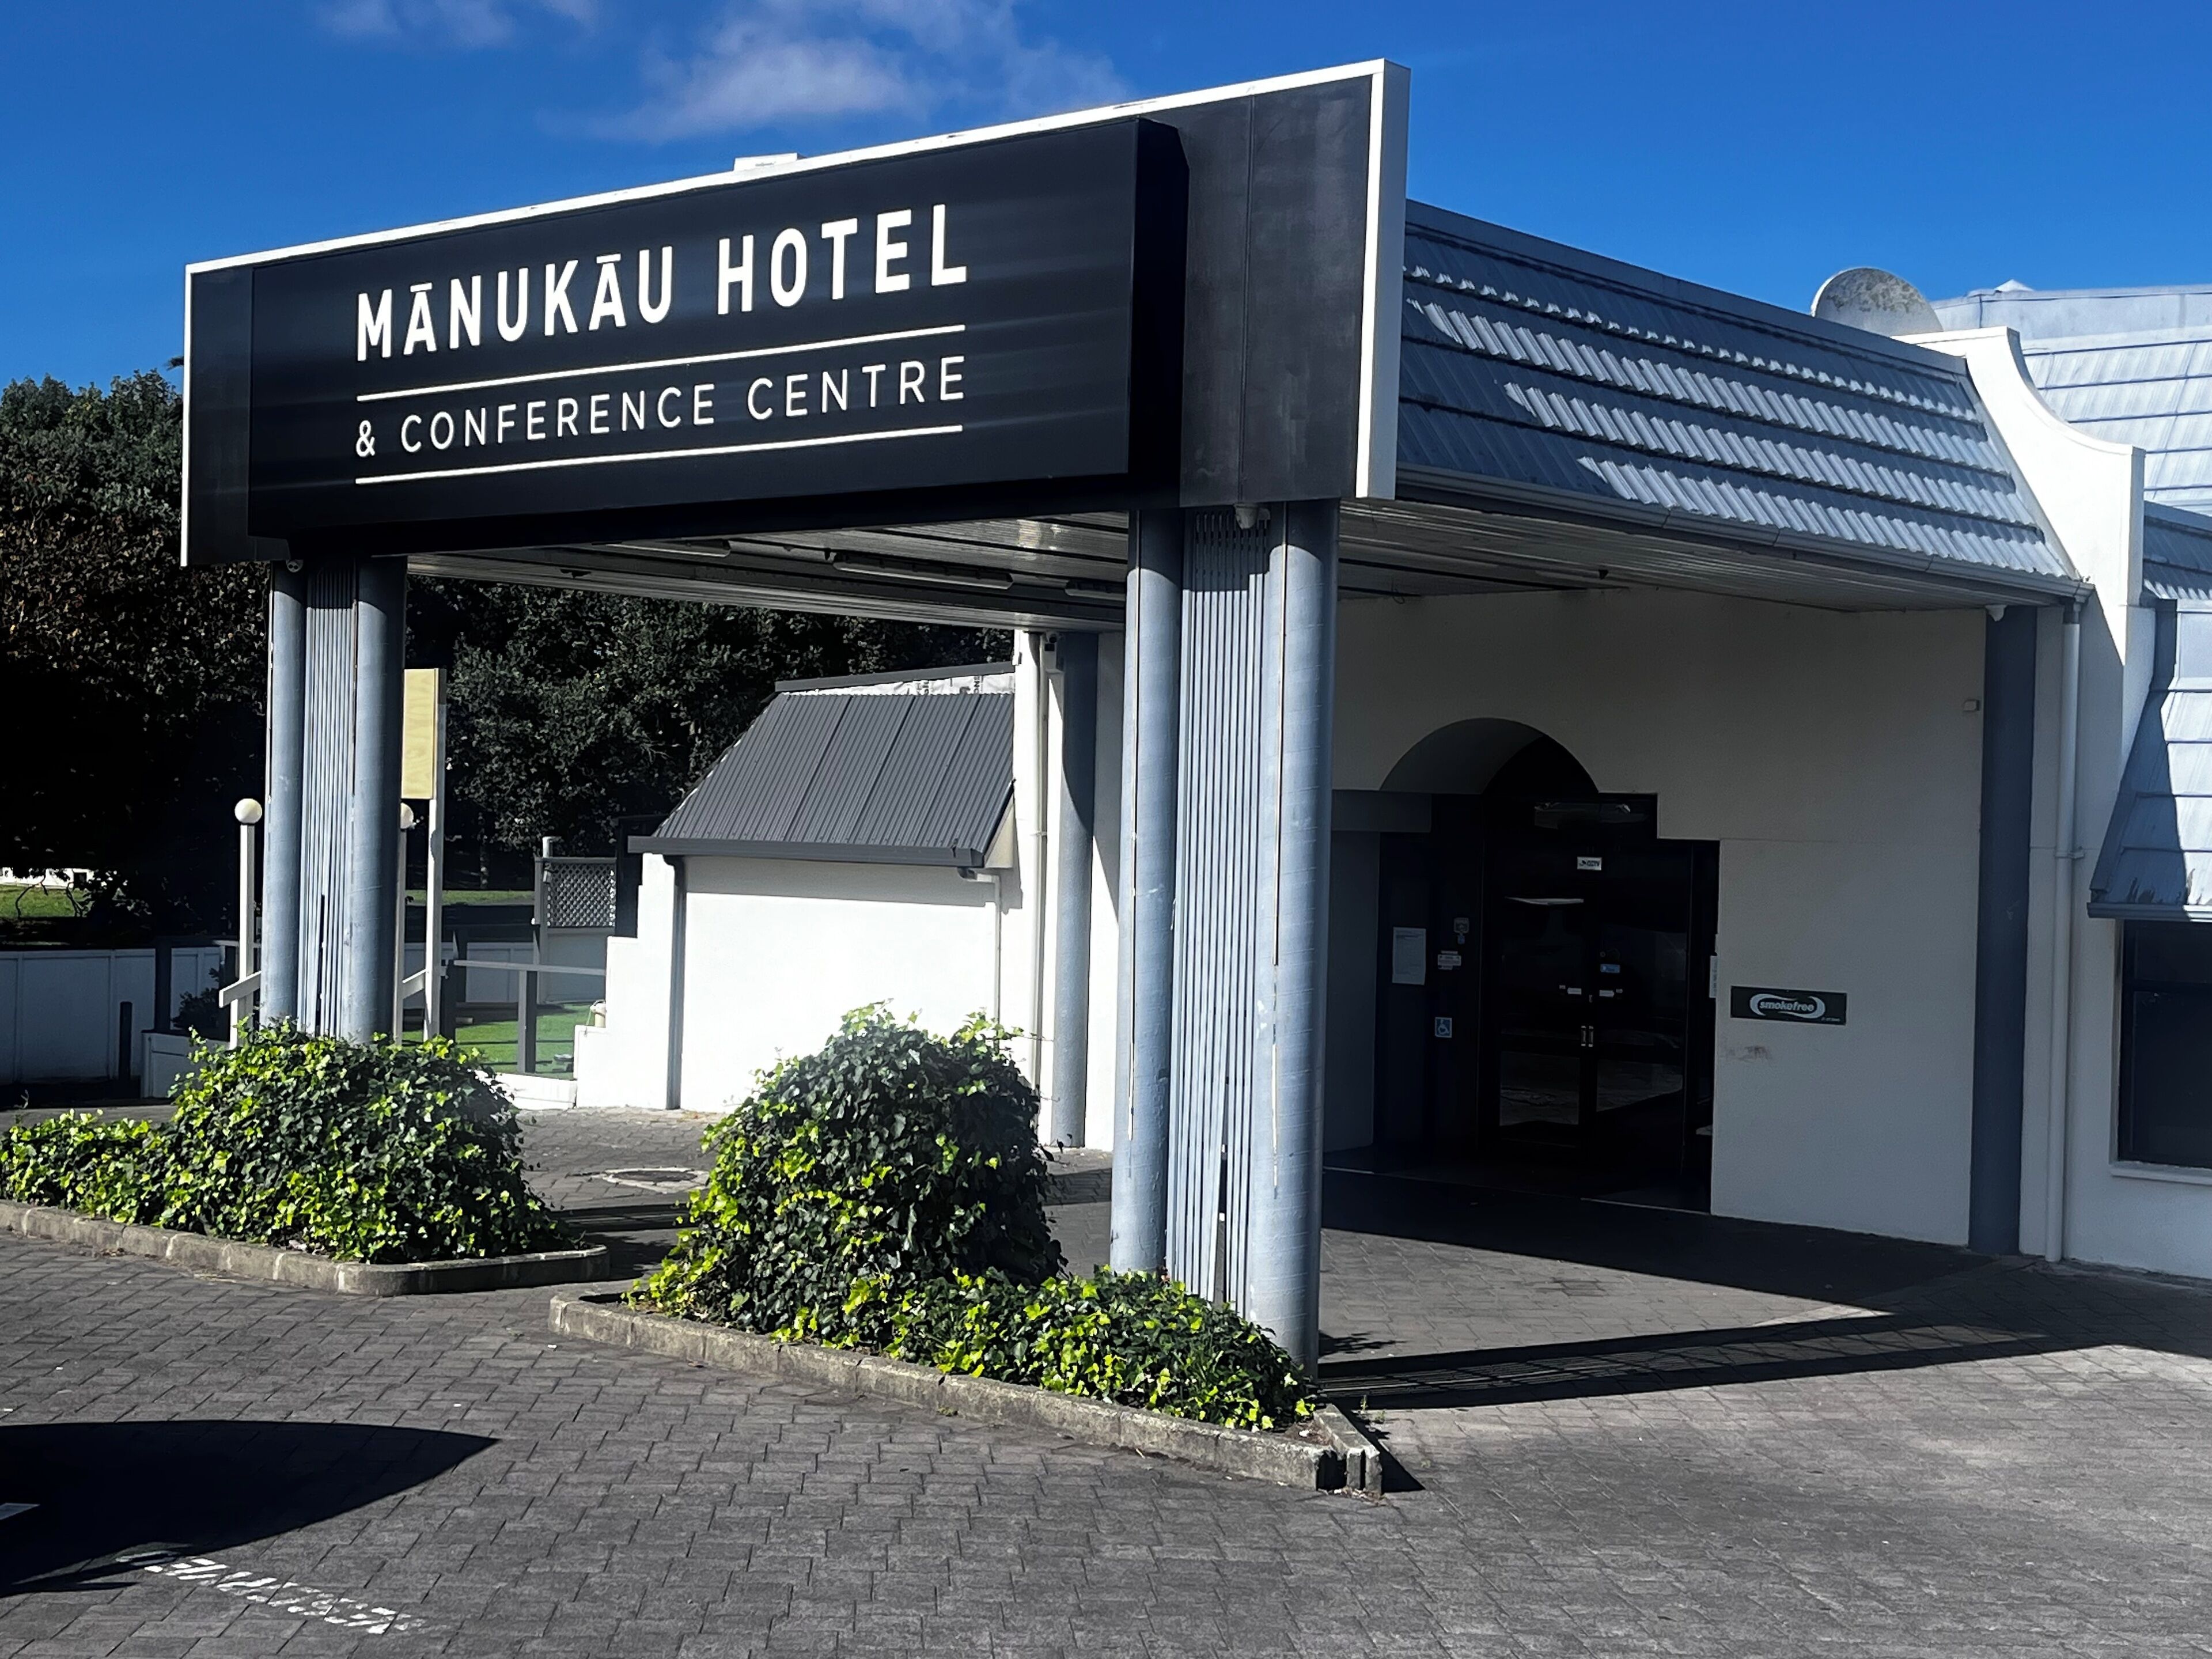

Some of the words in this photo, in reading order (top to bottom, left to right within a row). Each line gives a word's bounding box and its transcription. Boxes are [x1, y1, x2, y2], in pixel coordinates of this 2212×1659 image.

[357, 245, 673, 362] MĀNUKĀU
[717, 203, 968, 315] HOTEL
[355, 420, 376, 457] &
[400, 383, 715, 453] CONFERENCE
[747, 355, 965, 421] CENTRE
[1759, 1001, 1815, 1012] smokefree
